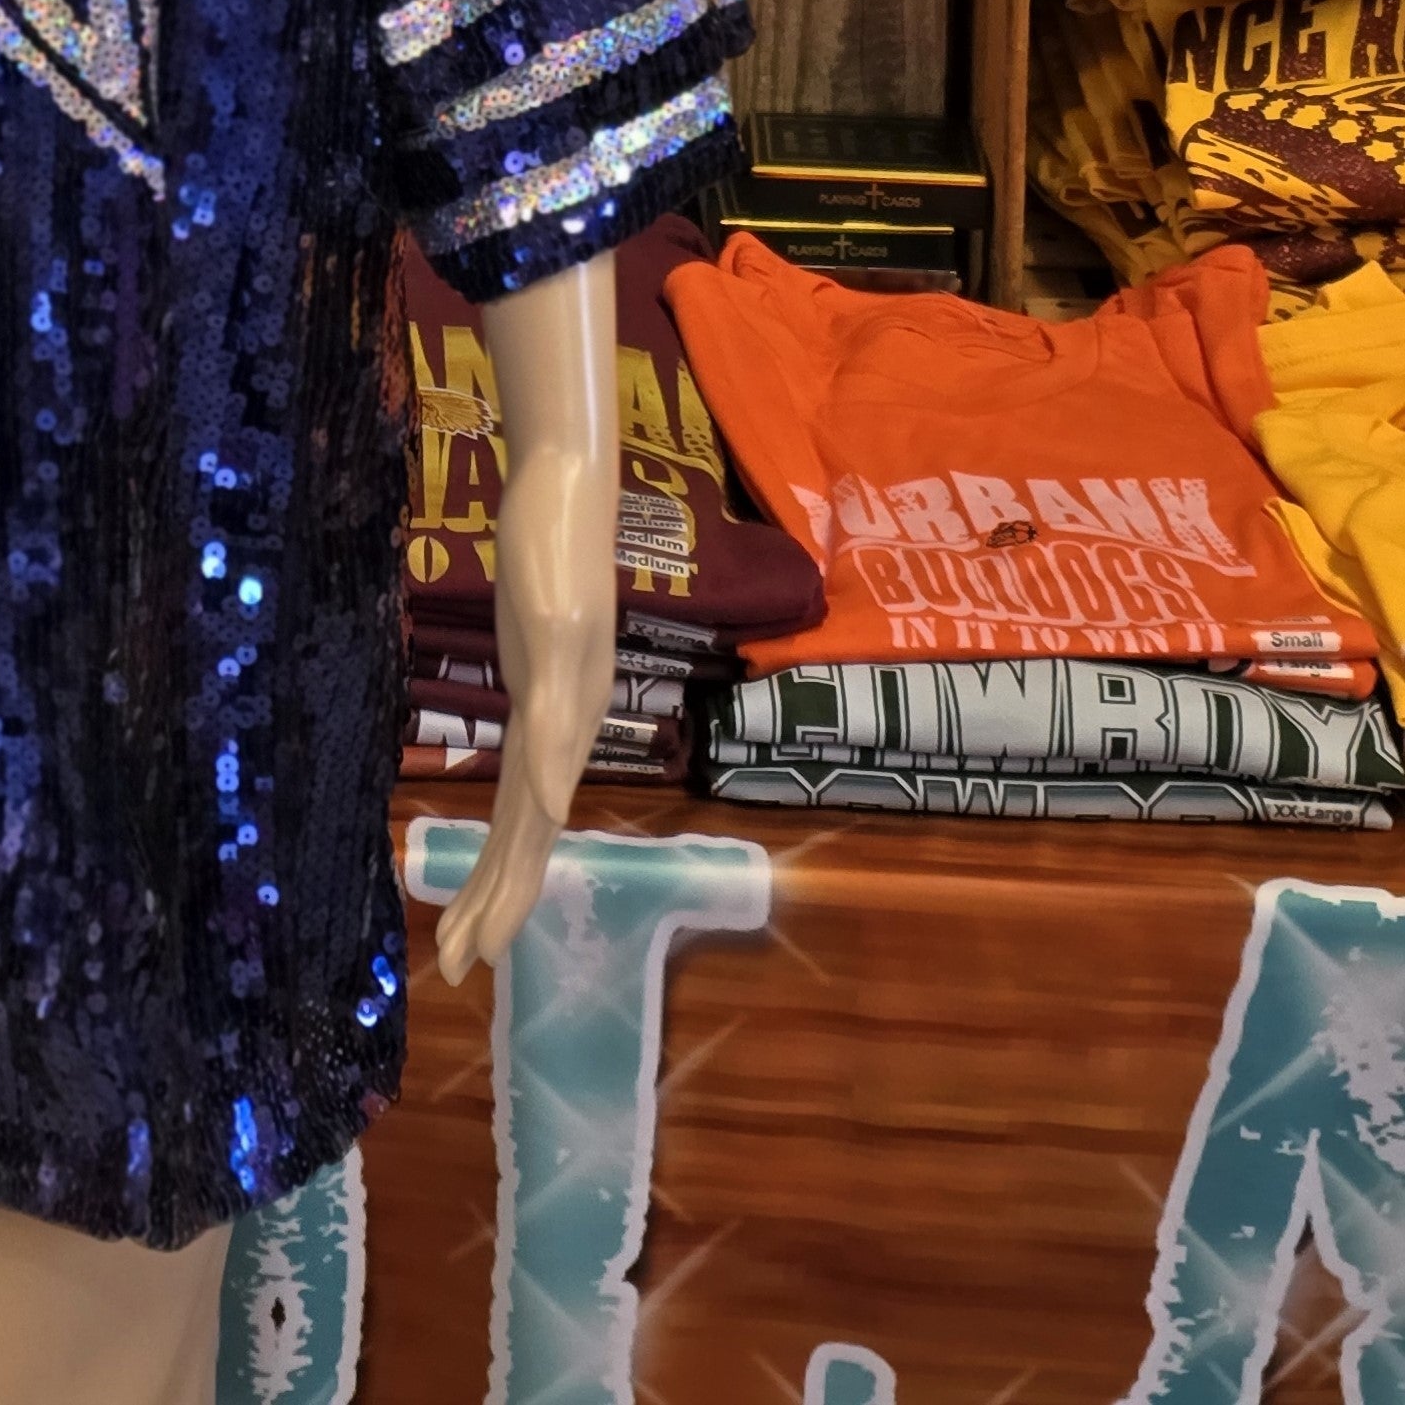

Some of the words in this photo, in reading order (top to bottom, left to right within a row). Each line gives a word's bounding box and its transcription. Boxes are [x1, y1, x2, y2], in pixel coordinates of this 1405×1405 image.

[889, 617, 938, 649] IN
[955, 619, 998, 651] IT
[1009, 623, 1070, 652] TO
[1081, 627, 1170, 654] WIN
[1180, 622, 1230, 653] IT
[1269, 631, 1325, 648] Small
[1273, 803, 1354, 824] XX-Large
